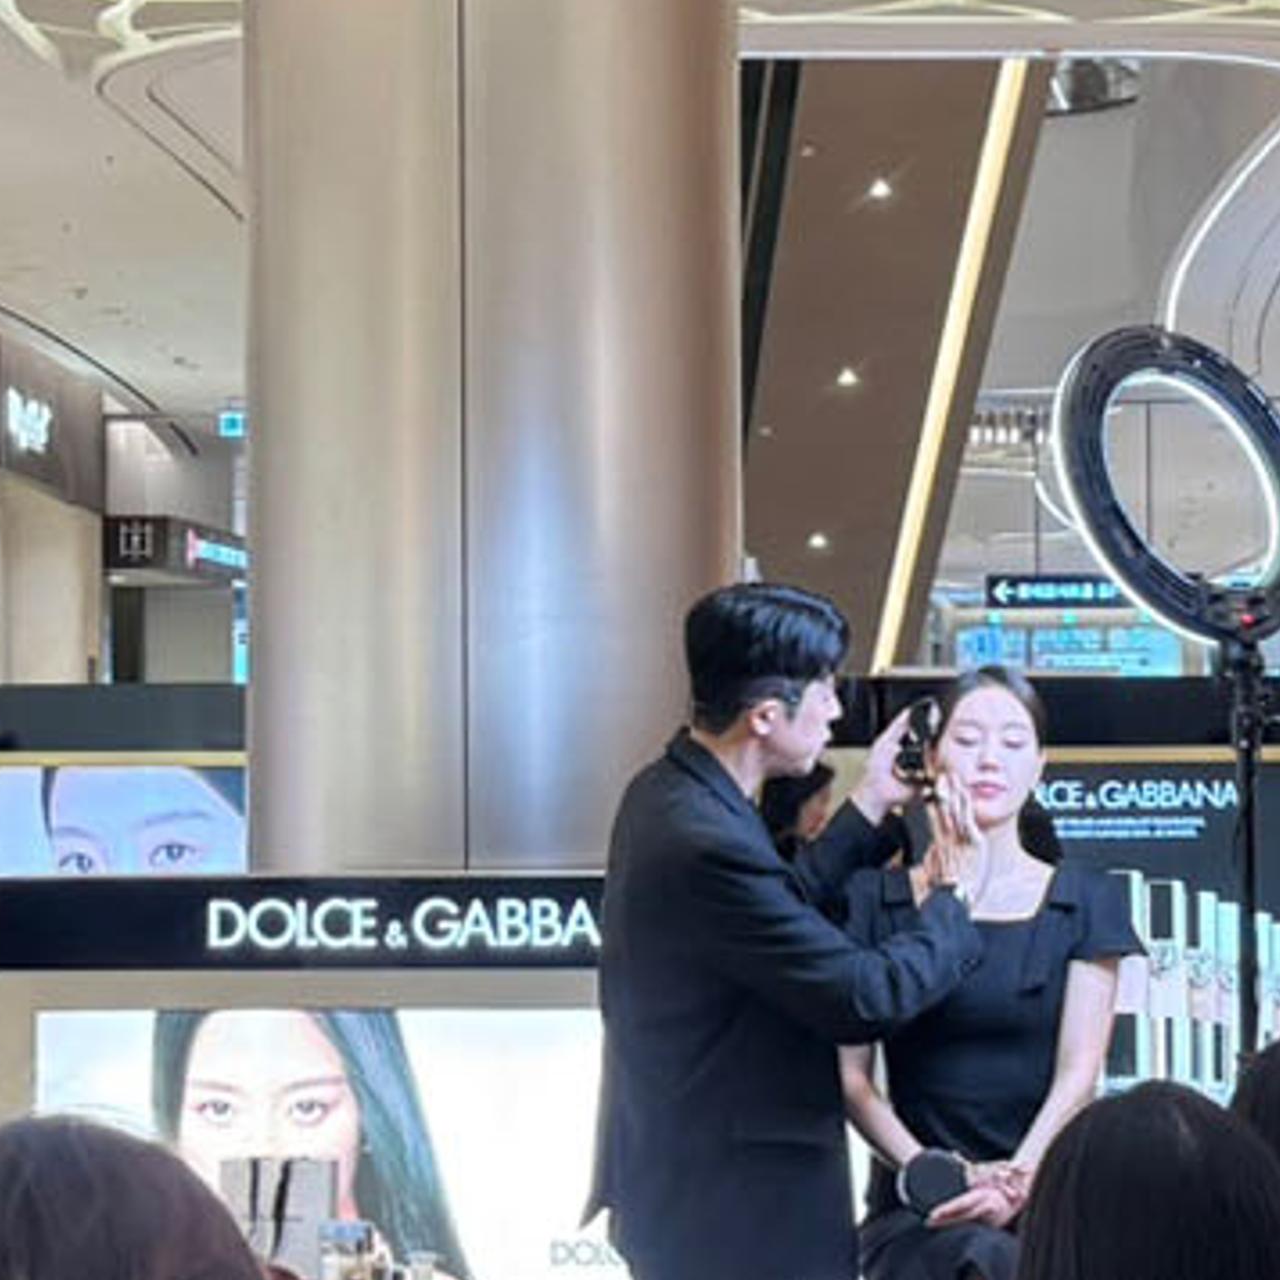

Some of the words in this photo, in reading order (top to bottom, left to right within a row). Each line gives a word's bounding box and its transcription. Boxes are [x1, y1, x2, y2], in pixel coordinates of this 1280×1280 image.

[1099, 780, 1239, 810] GABBANA
[207, 898, 379, 948] DOLCE
[412, 898, 602, 948] GABBA
